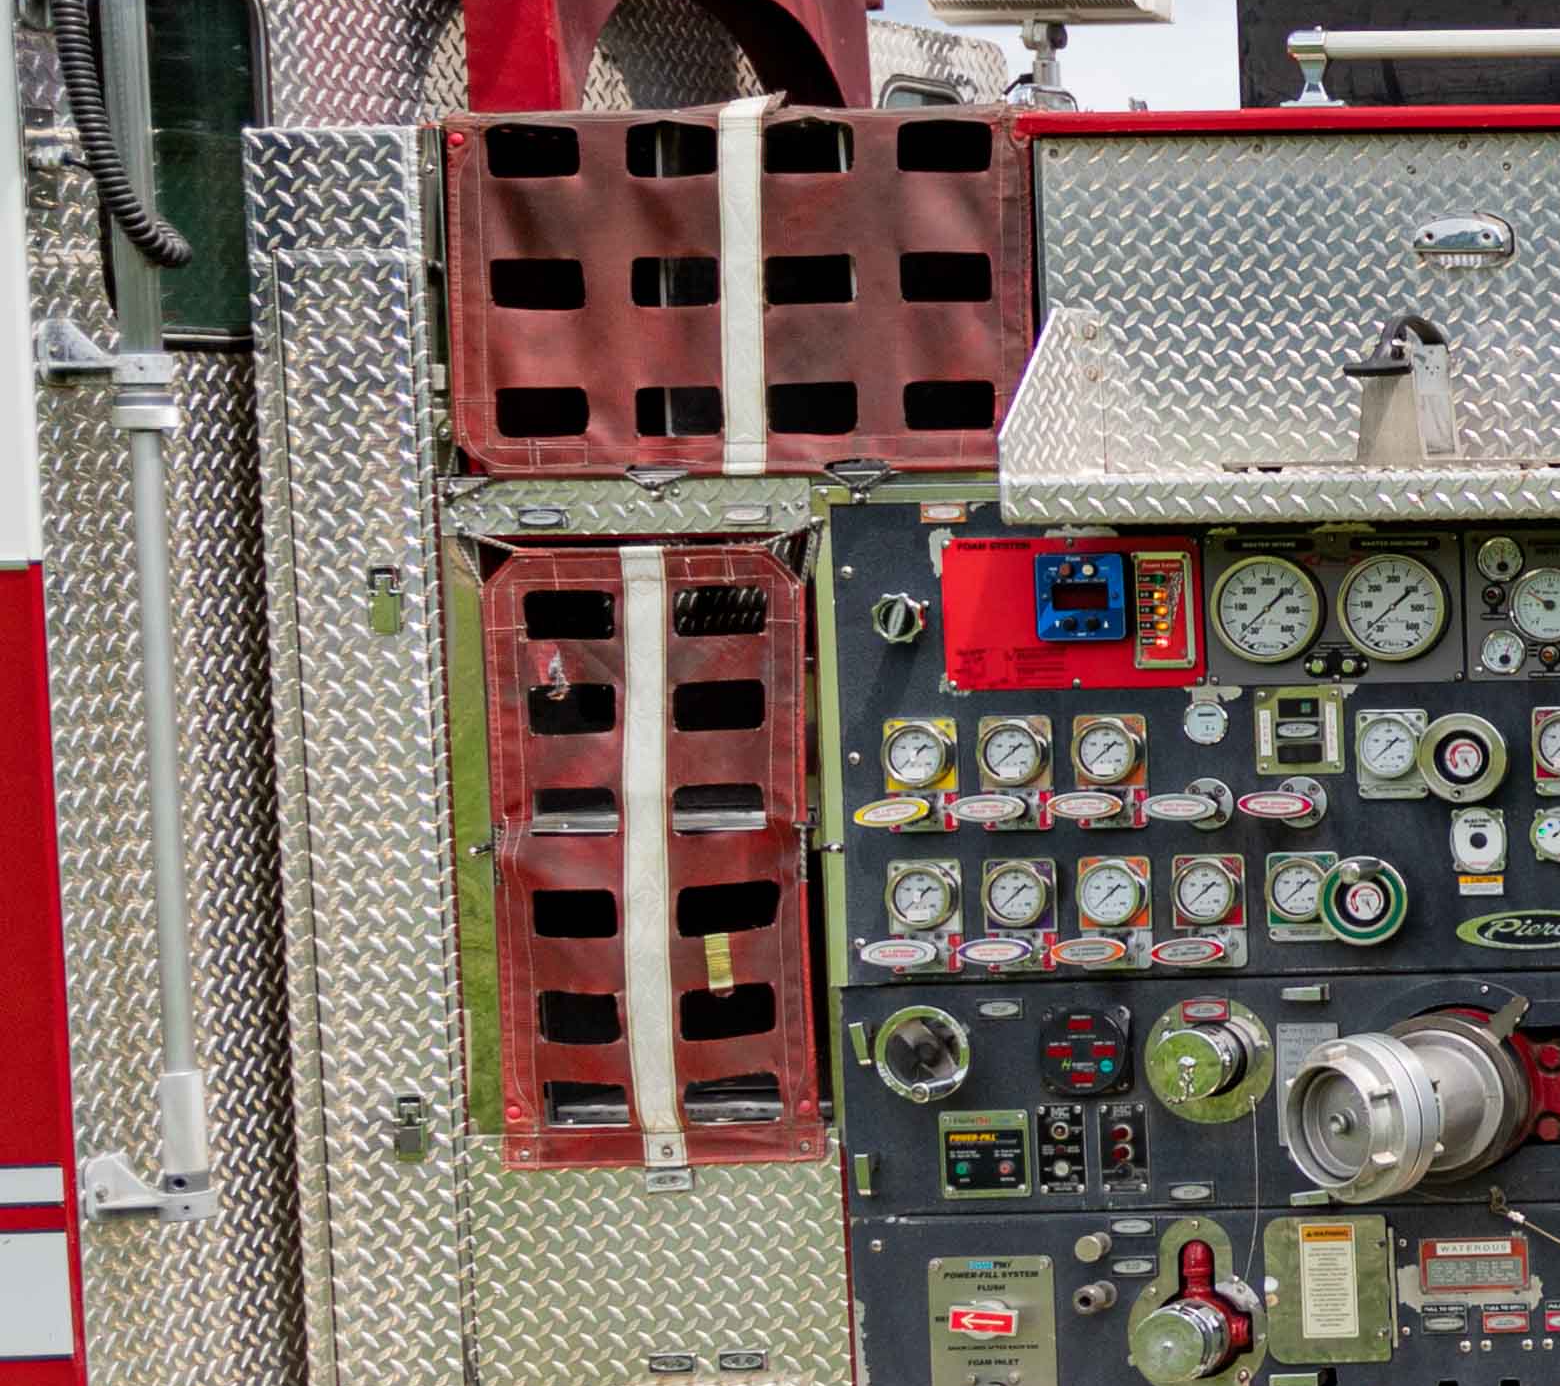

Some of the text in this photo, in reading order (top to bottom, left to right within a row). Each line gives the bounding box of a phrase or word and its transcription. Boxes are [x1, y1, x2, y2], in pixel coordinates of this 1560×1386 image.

[1439, 1244, 1508, 1253] WATEROUS
[943, 1270, 1039, 1279] POWER-FILL SYSTEM
